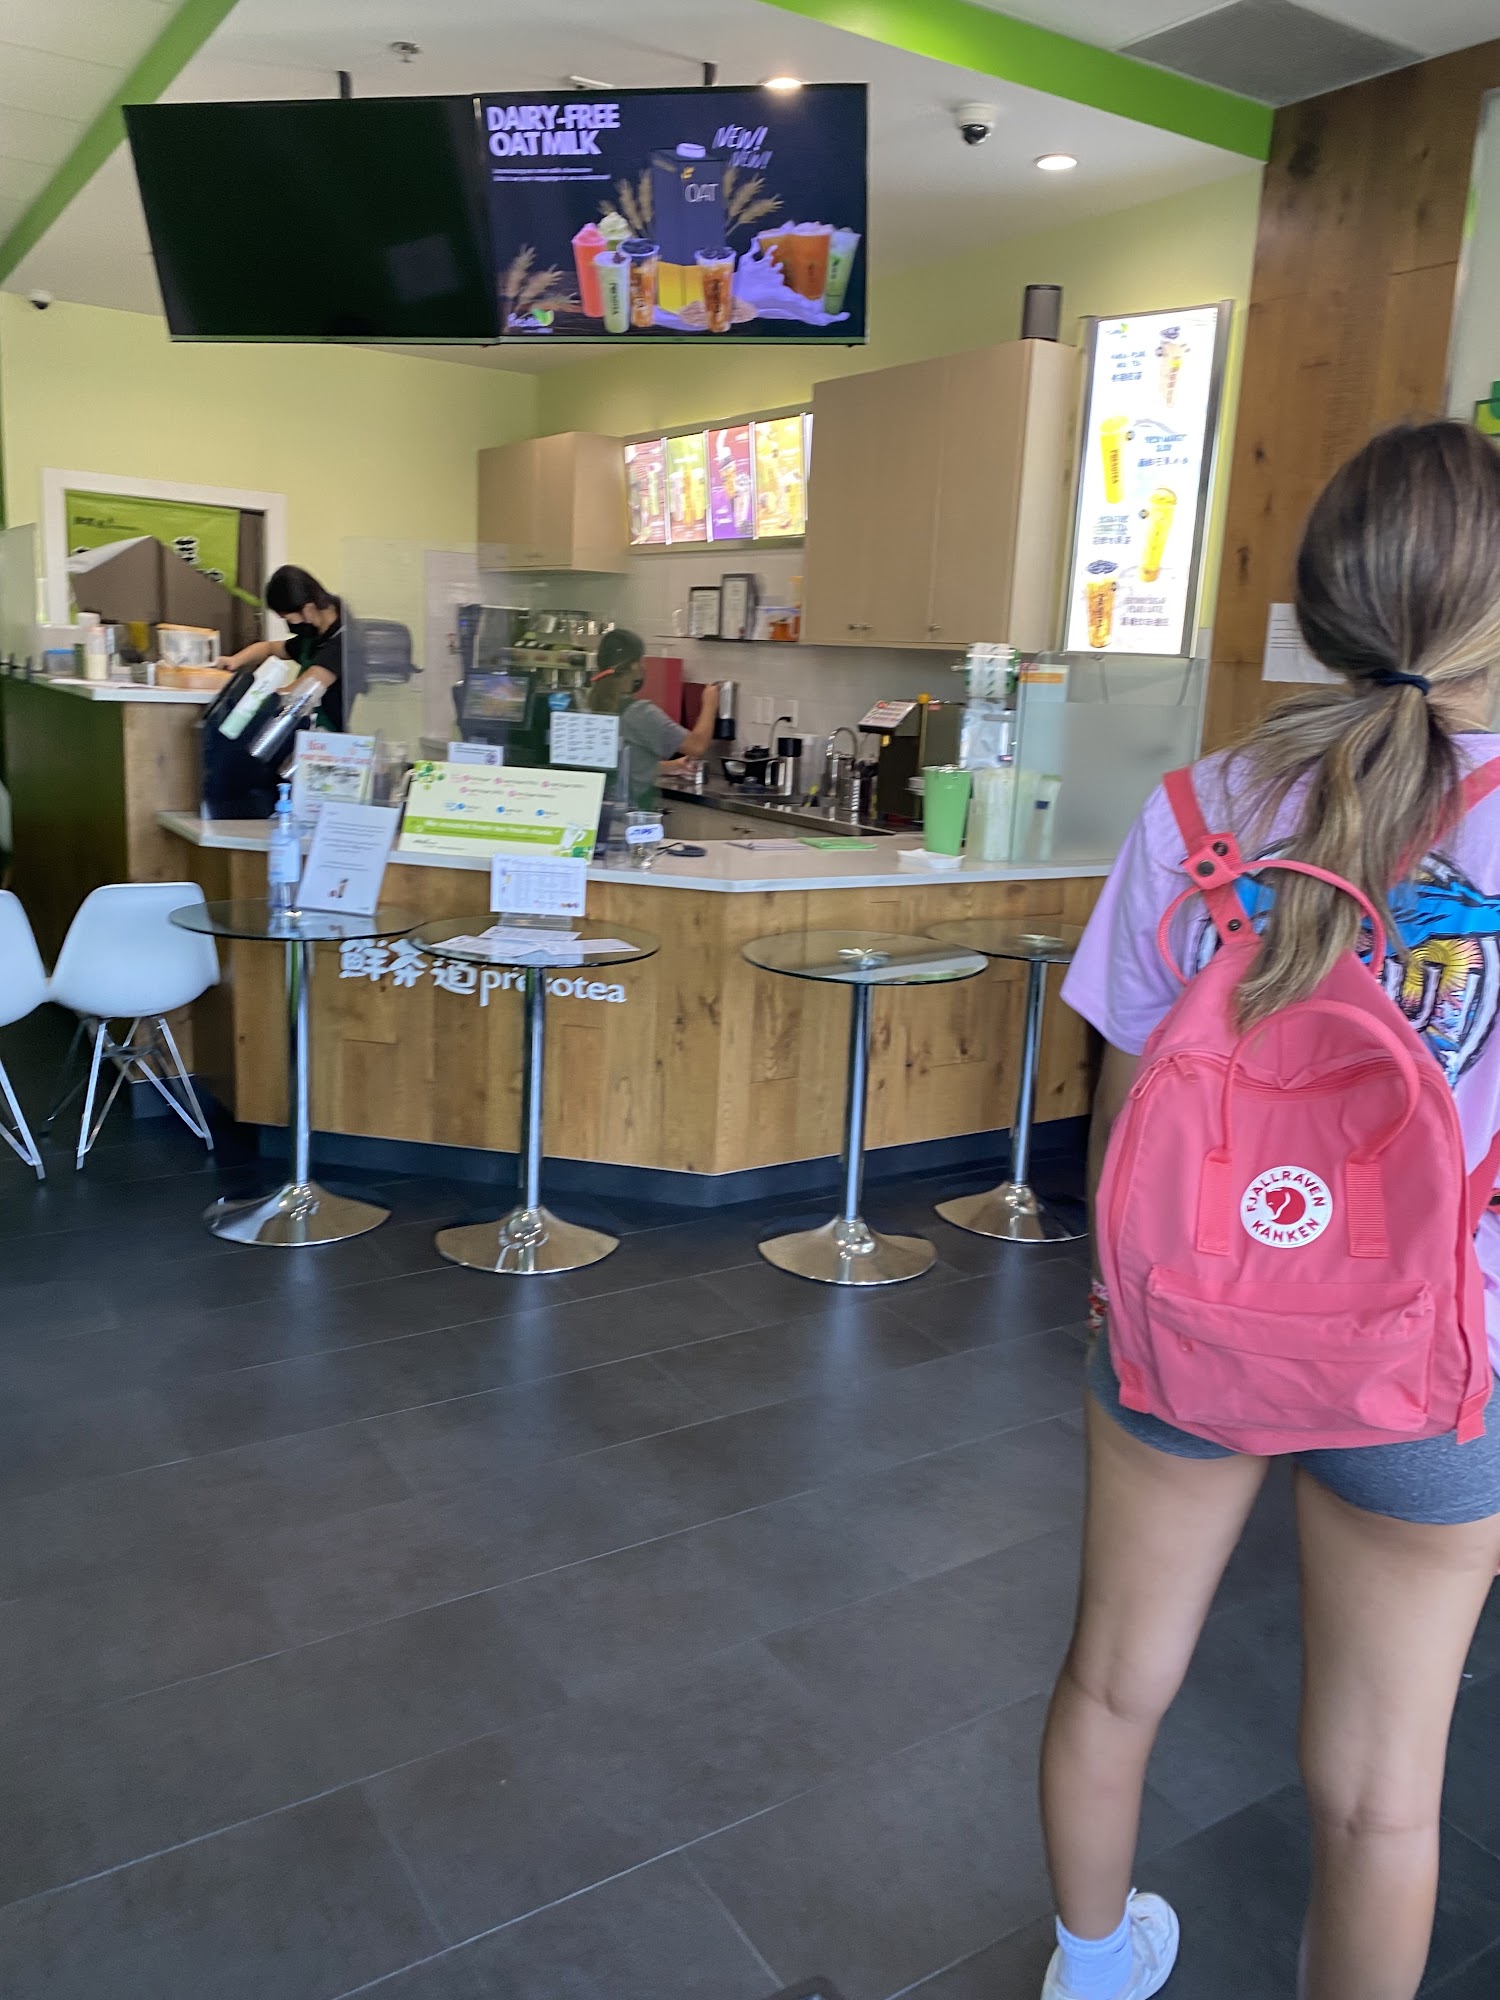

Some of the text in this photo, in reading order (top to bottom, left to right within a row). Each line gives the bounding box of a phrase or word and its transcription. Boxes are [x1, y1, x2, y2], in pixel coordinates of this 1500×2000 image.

[486, 103, 621, 131] DAIRY-FREE
[488, 130, 602, 156] OAT MILK
[711, 123, 769, 151] NEW!
[684, 183, 720, 203] OAT
